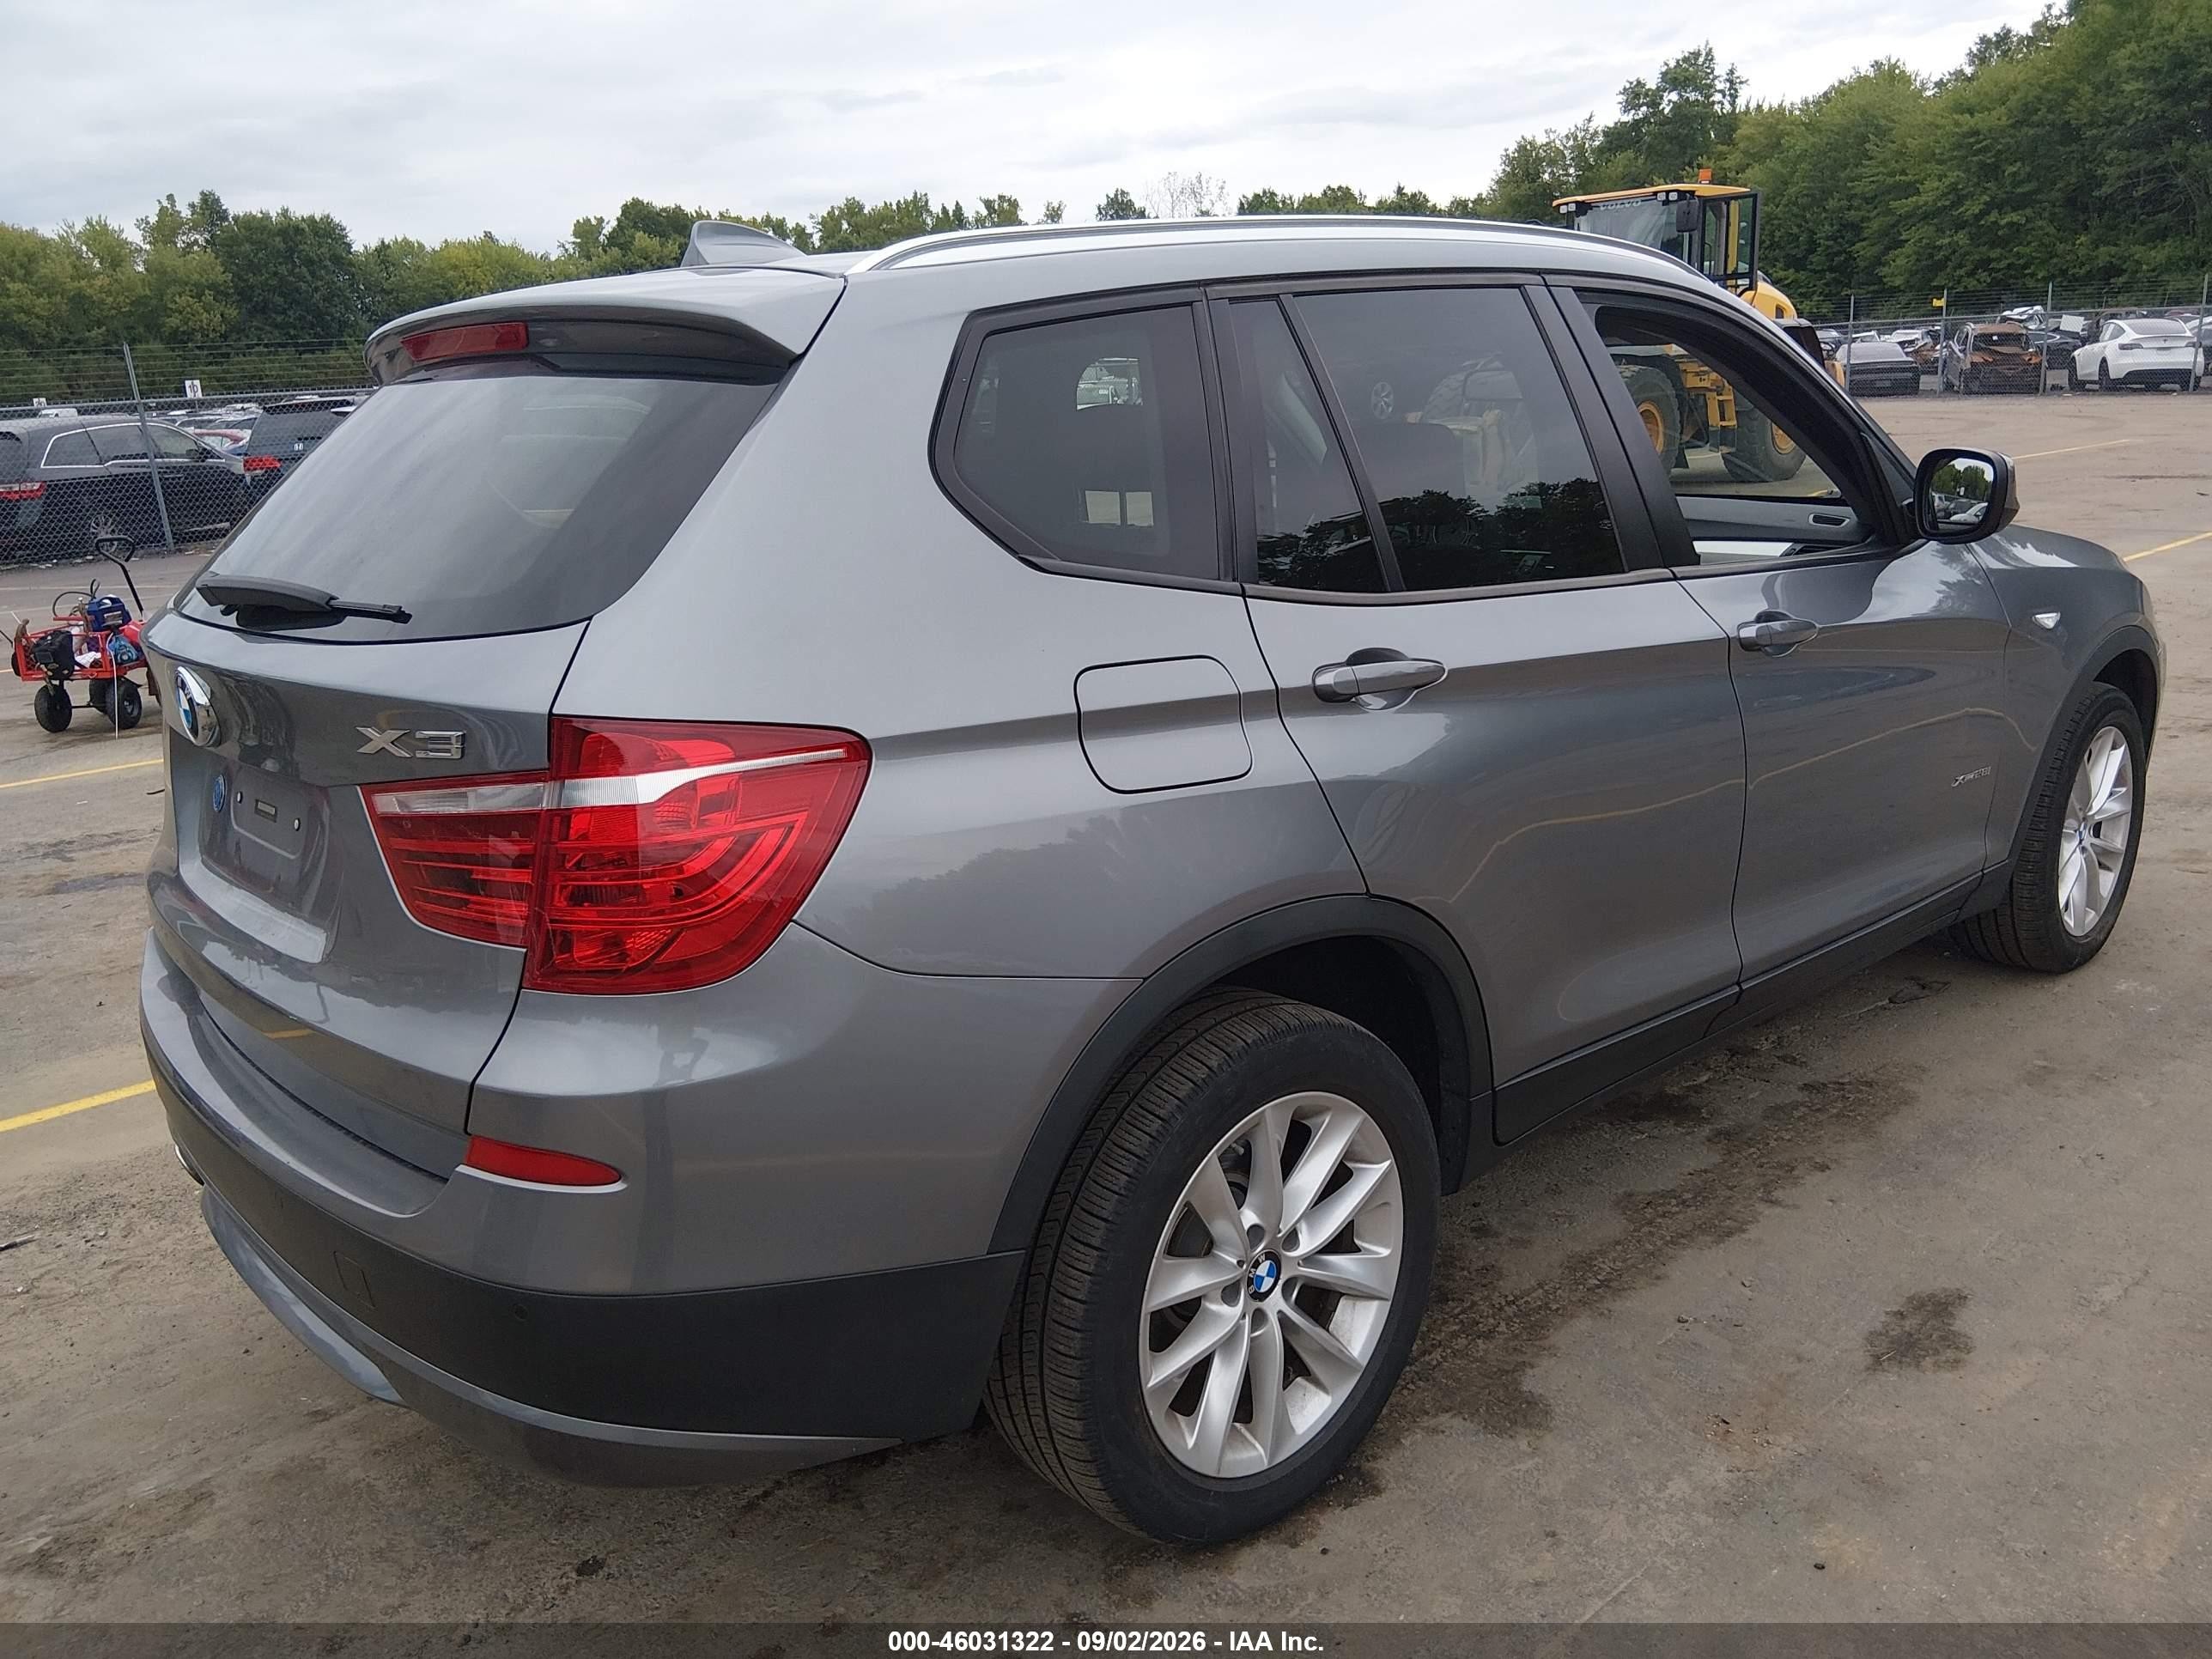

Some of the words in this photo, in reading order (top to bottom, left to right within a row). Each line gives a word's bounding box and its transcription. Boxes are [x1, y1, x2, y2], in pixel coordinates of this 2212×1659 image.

[1600, 199, 1642, 210] VOLVO
[356, 726, 465, 758] X3
[1248, 1253, 1266, 1294] BMW
